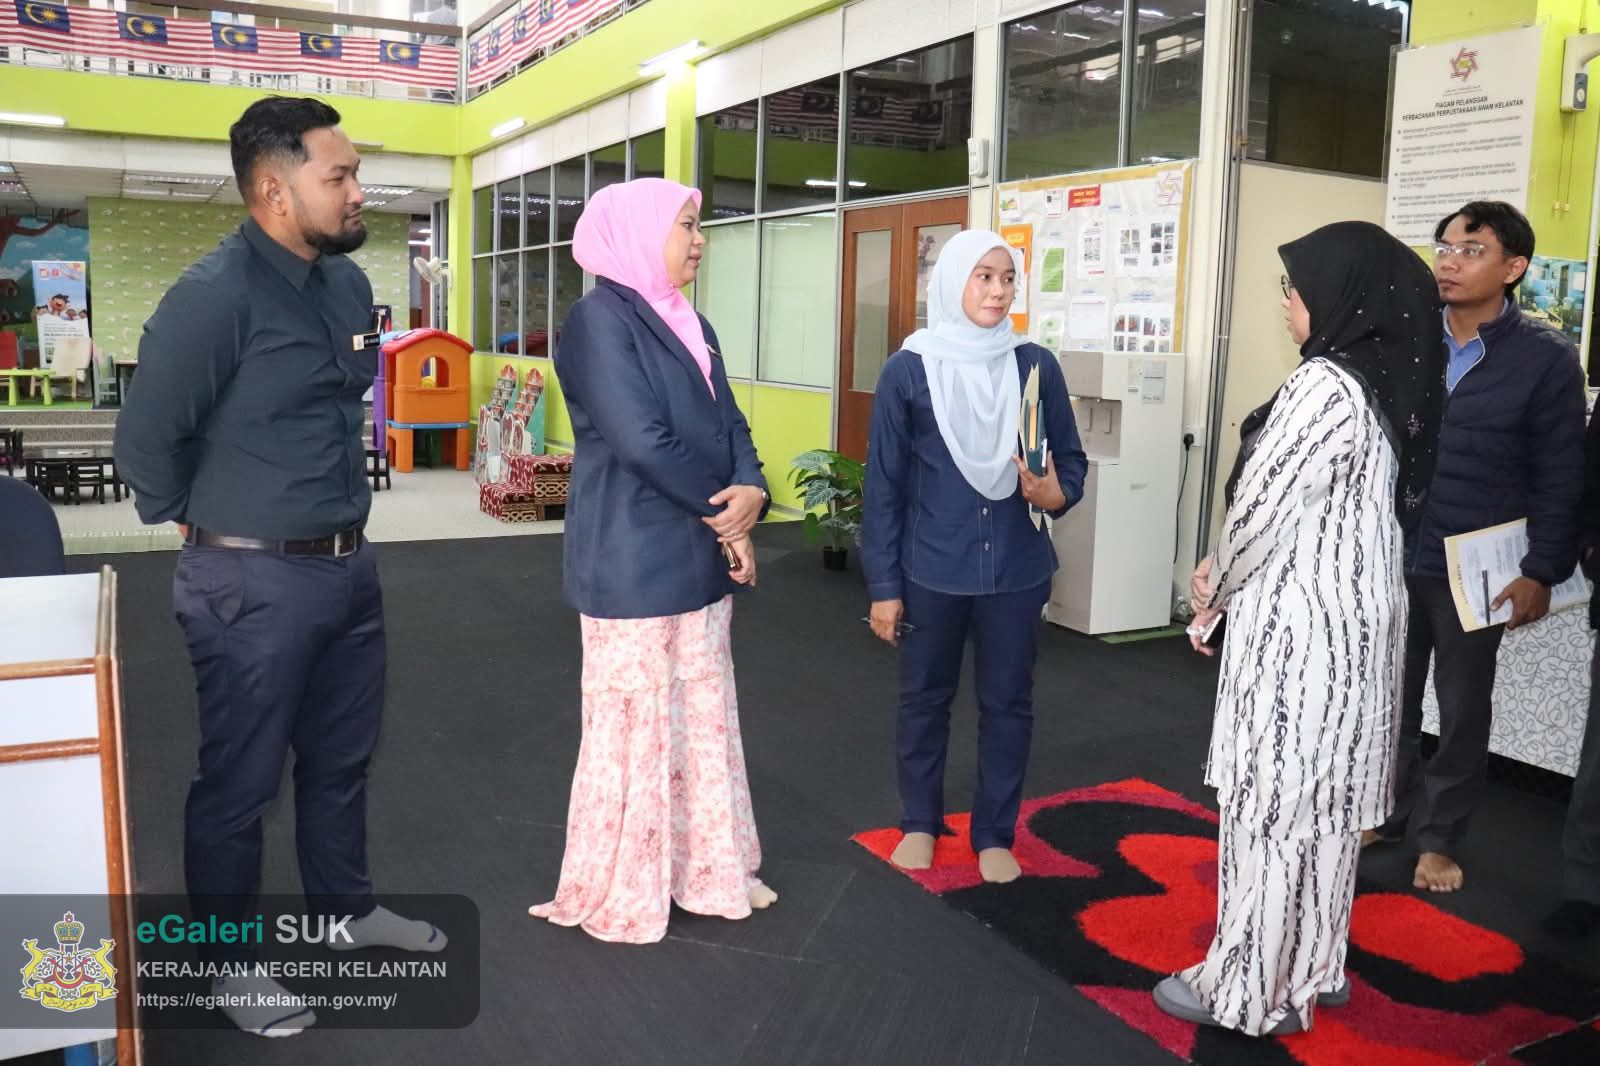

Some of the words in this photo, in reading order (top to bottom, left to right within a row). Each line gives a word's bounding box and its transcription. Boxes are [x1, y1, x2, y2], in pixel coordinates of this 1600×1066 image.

[1455, 96, 1488, 106] PELANGGAN
[1402, 112, 1435, 120] PERBADANAN
[1436, 106, 1477, 117] PERPUSTAKAAN
[1478, 103, 1494, 111] AWAM
[1494, 99, 1524, 109] KELANTAN
